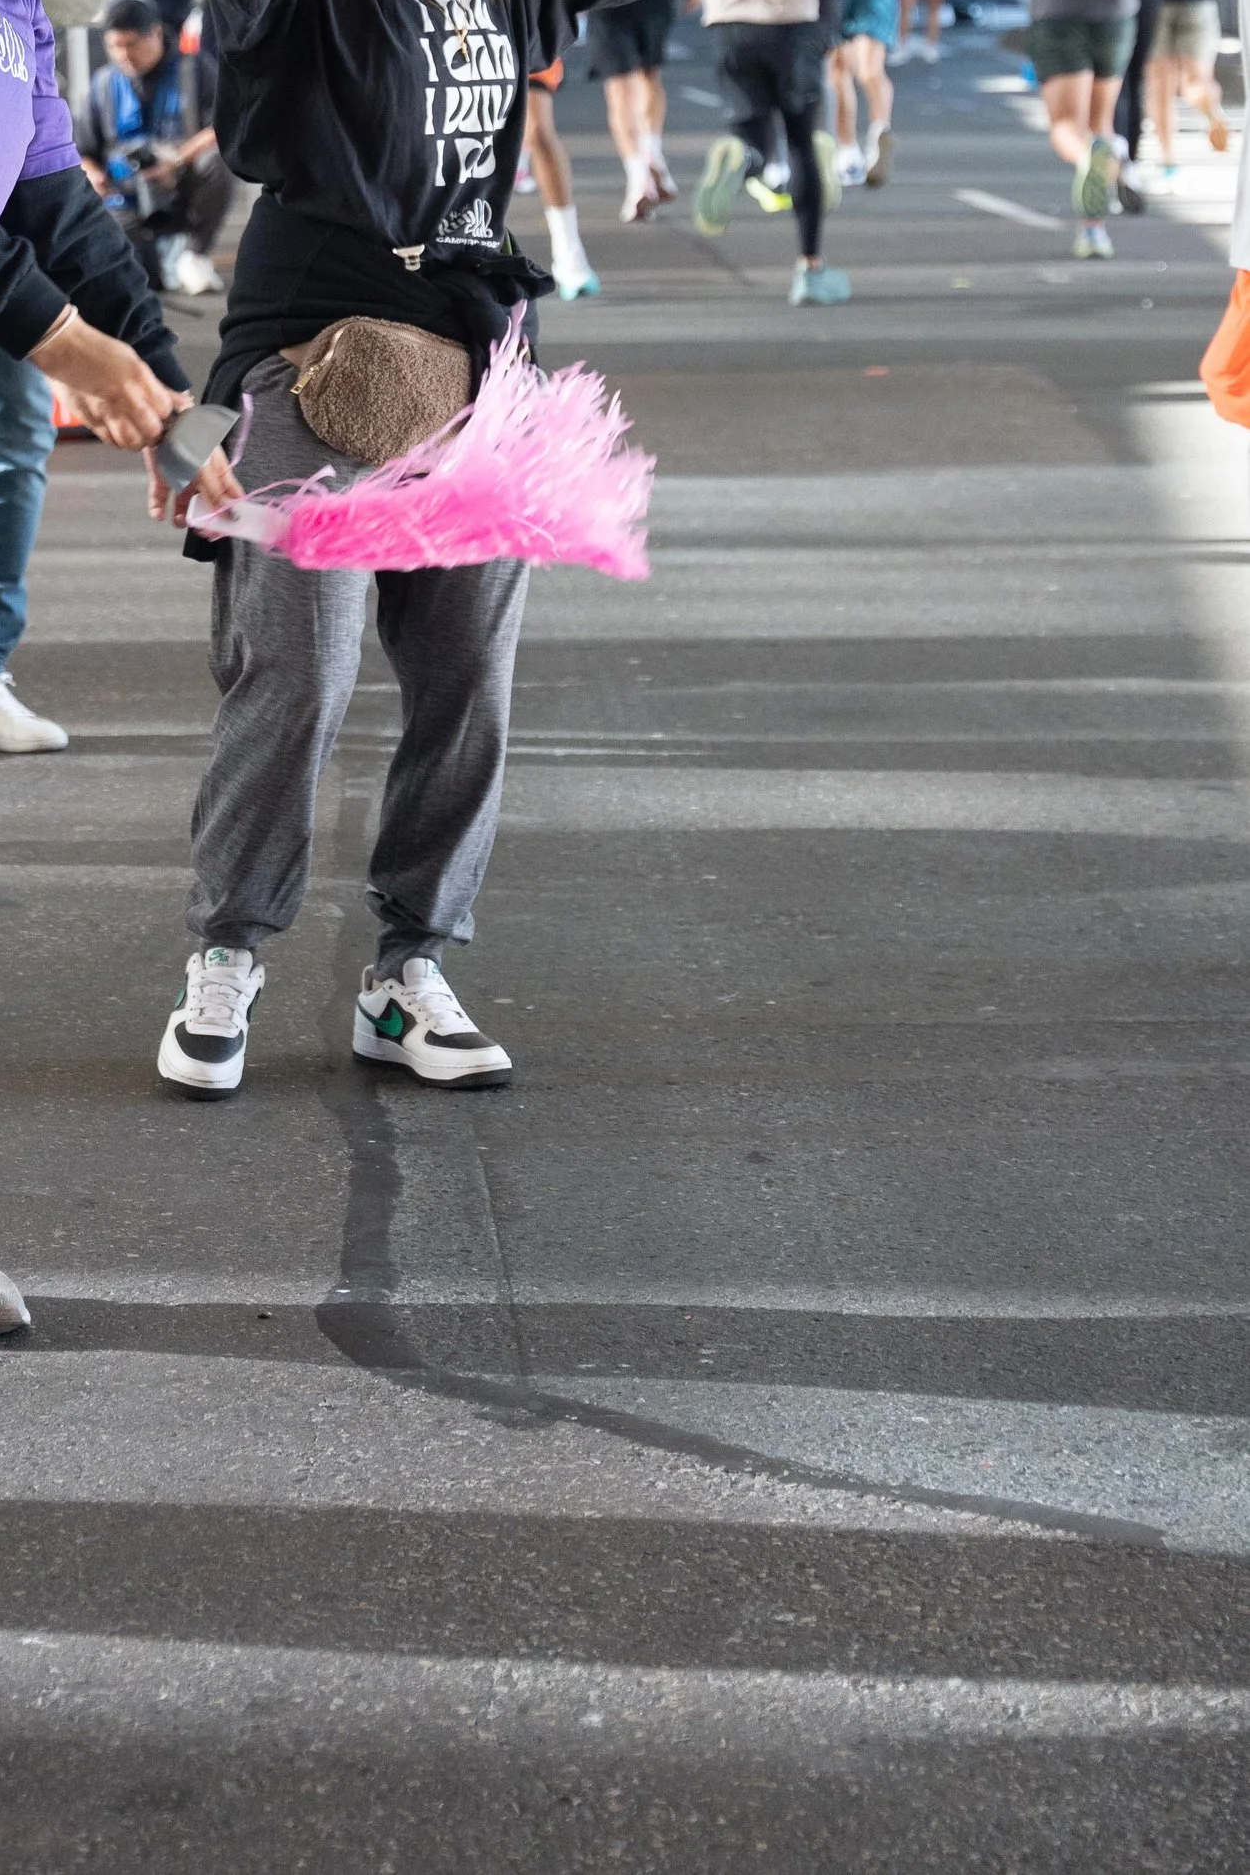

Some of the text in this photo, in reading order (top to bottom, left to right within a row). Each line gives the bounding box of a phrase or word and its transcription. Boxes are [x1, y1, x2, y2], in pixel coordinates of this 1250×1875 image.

[419, 33, 516, 82] I CAN
[424, 87, 436, 135] I
[435, 139, 446, 187] I
